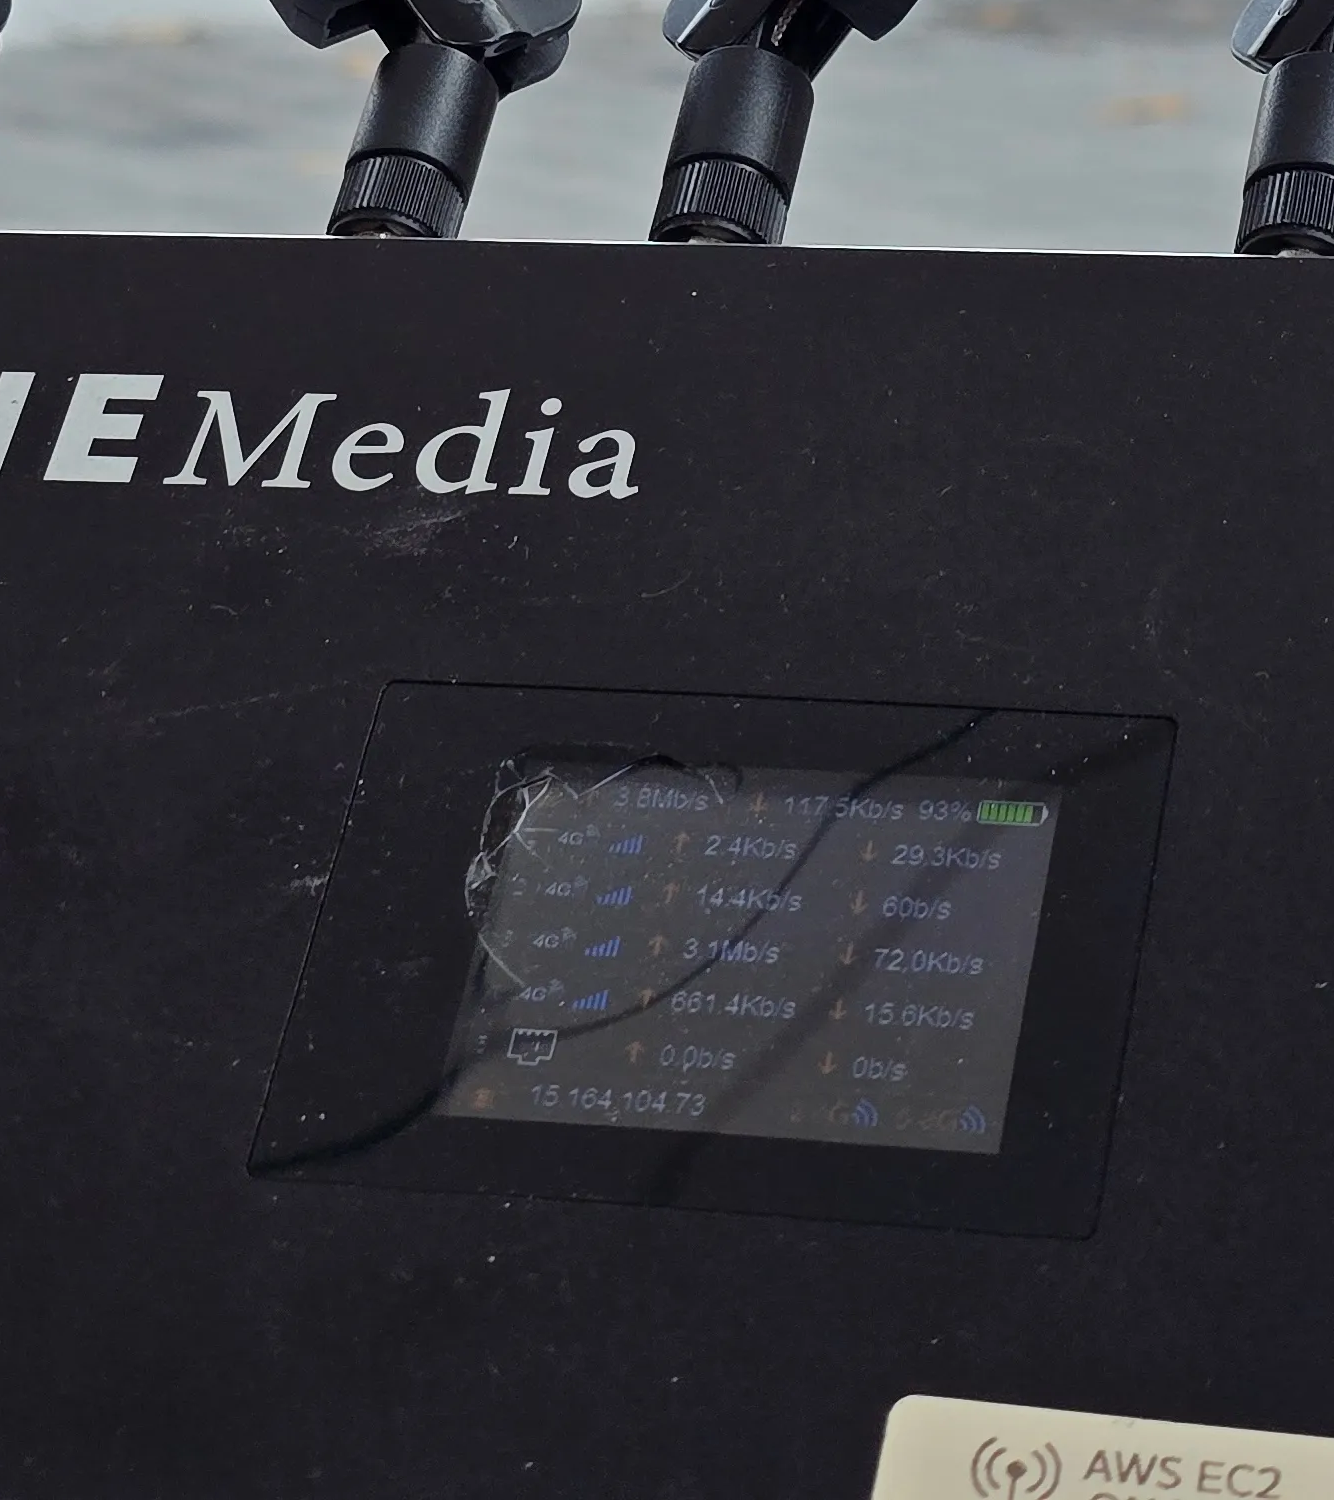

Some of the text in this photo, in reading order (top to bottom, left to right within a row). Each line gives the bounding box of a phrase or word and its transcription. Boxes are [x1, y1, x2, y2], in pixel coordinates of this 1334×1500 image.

[162, 388, 639, 499] Media
[785, 796, 904, 820] 1175Kb/s
[919, 800, 972, 823] 93%
[891, 843, 1002, 870] 29.3Kb/s
[883, 896, 952, 920] 60b/s
[533, 934, 560, 949] 4G
[519, 986, 548, 1002] 4G
[1083, 1449, 1282, 1499] AWS EC2
